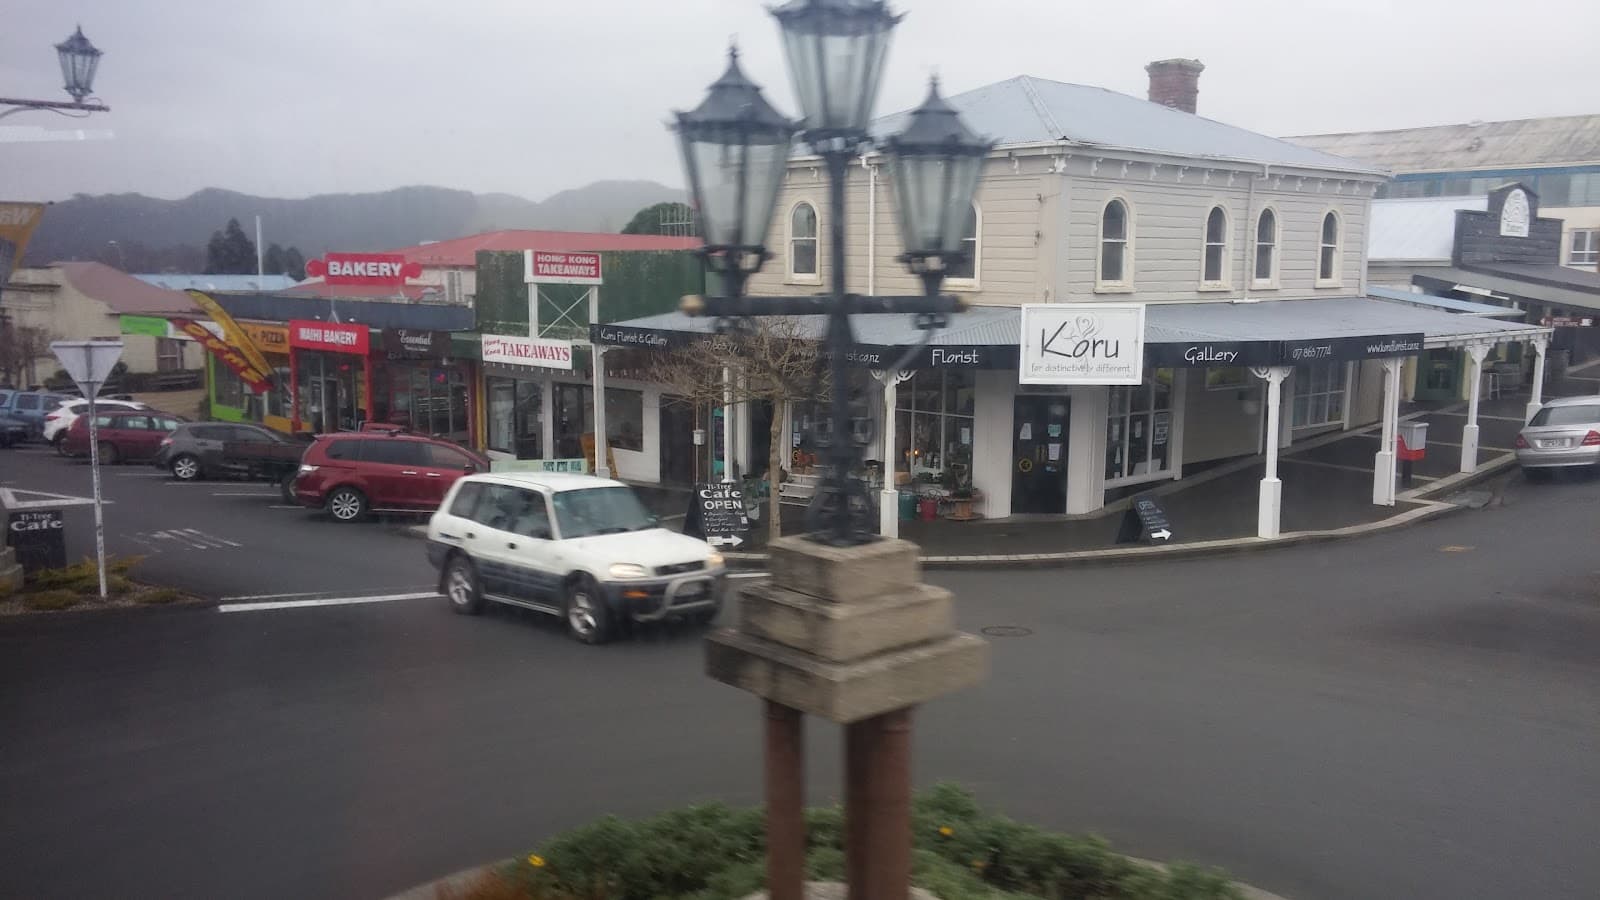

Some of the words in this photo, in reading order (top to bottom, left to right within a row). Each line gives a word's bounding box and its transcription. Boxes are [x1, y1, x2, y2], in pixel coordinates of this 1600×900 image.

[537, 254, 566, 263] HONG
[569, 255, 597, 264] KONG
[328, 260, 402, 276] BAKERY
[537, 263, 596, 276] TAKEAWAYS
[299, 327, 322, 341] WAIHI
[324, 329, 358, 345] BAKERY
[617, 331, 637, 344] Florist
[645, 334, 668, 347] Gallery
[1041, 321, 1119, 358] Koru
[501, 342, 570, 362] TAKEAWAYS
[932, 348, 979, 366] Florist
[1184, 346, 1238, 363] Gallery
[1292, 348, 1303, 360] 07
[1031, 363, 1043, 372] for
[1096, 362, 1131, 374] different
[700, 489, 742, 499] Cafe
[704, 500, 743, 510] OPEN
[10, 519, 63, 531] Cafe
